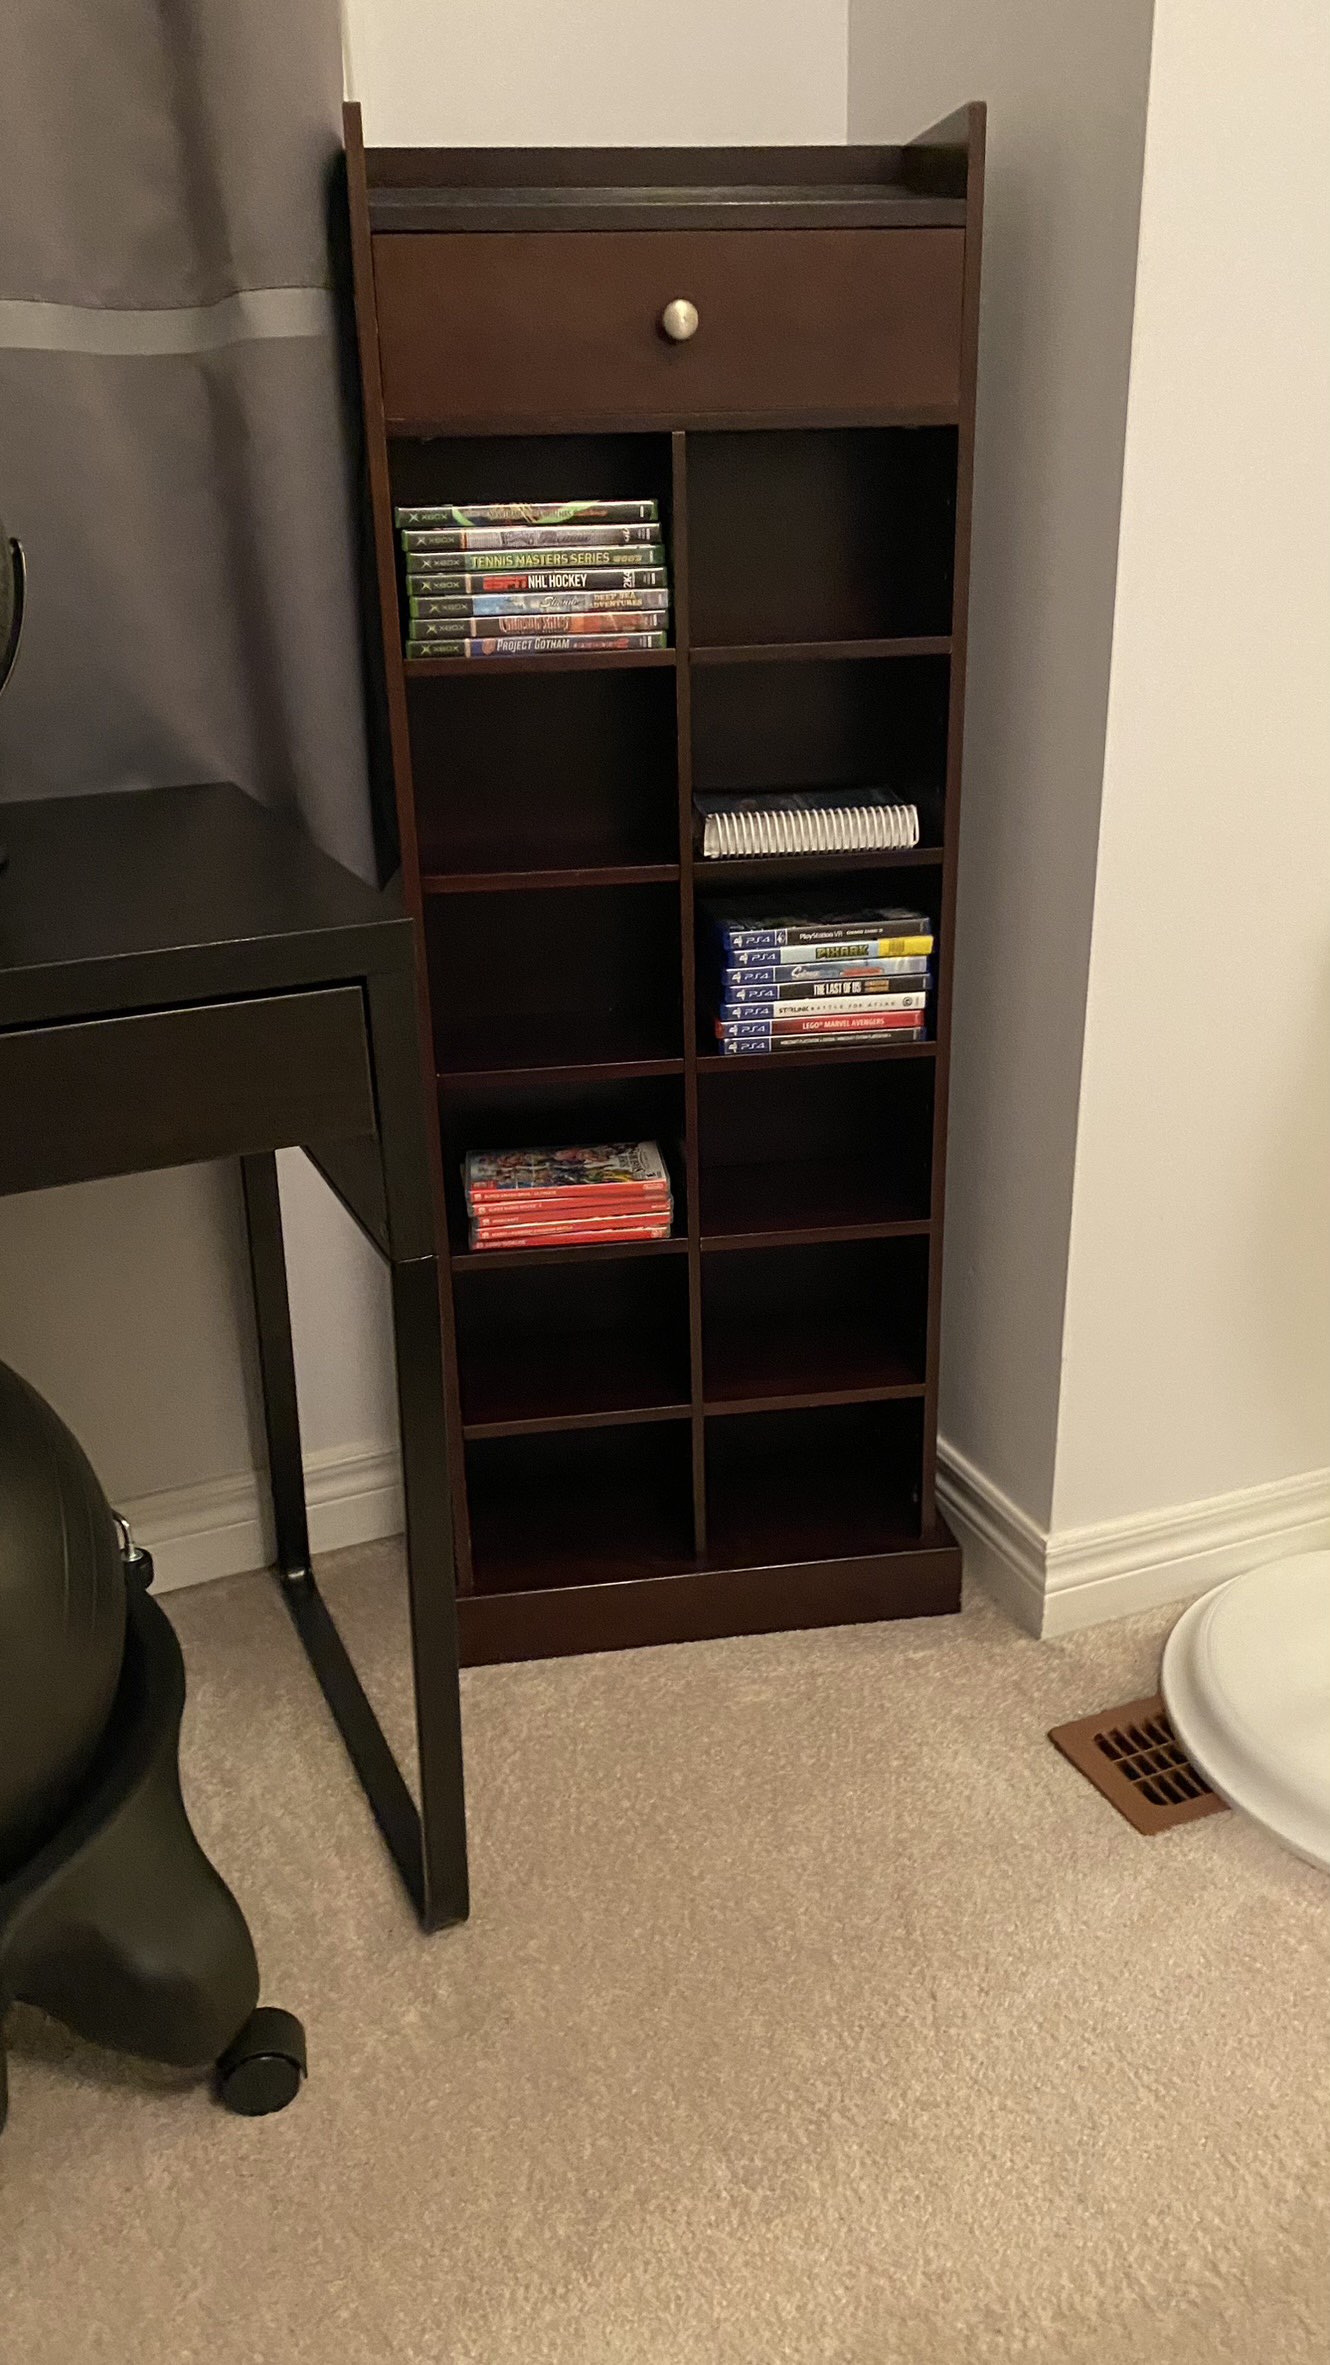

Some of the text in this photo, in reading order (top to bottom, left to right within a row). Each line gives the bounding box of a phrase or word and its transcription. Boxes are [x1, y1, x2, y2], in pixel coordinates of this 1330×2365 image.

[471, 555, 513, 568] TENNIS
[516, 554, 568, 567] MASTERS
[570, 552, 610, 564] SERIES
[528, 575, 546, 589] NHL
[549, 573, 588, 588] HOCKEY
[496, 639, 533, 653] PROJECT
[534, 637, 570, 650] GOTHAM
[745, 936, 770, 944] PS4
[799, 932, 834, 941] PlayStation
[834, 930, 843, 938] VR
[751, 953, 776, 961] PS4
[816, 944, 869, 959] PIXARK
[744, 972, 769, 980] PS4
[813, 983, 826, 996] THE
[826, 982, 842, 995] LAST
[843, 981, 852, 994] OF
[852, 981, 861, 993] US
[744, 1007, 769, 1016] PS4
[741, 1025, 766, 1033] PS4
[823, 1020, 850, 1029] MARVEL
[851, 1018, 885, 1027] AVENGERS
[740, 1042, 765, 1050] PS4
